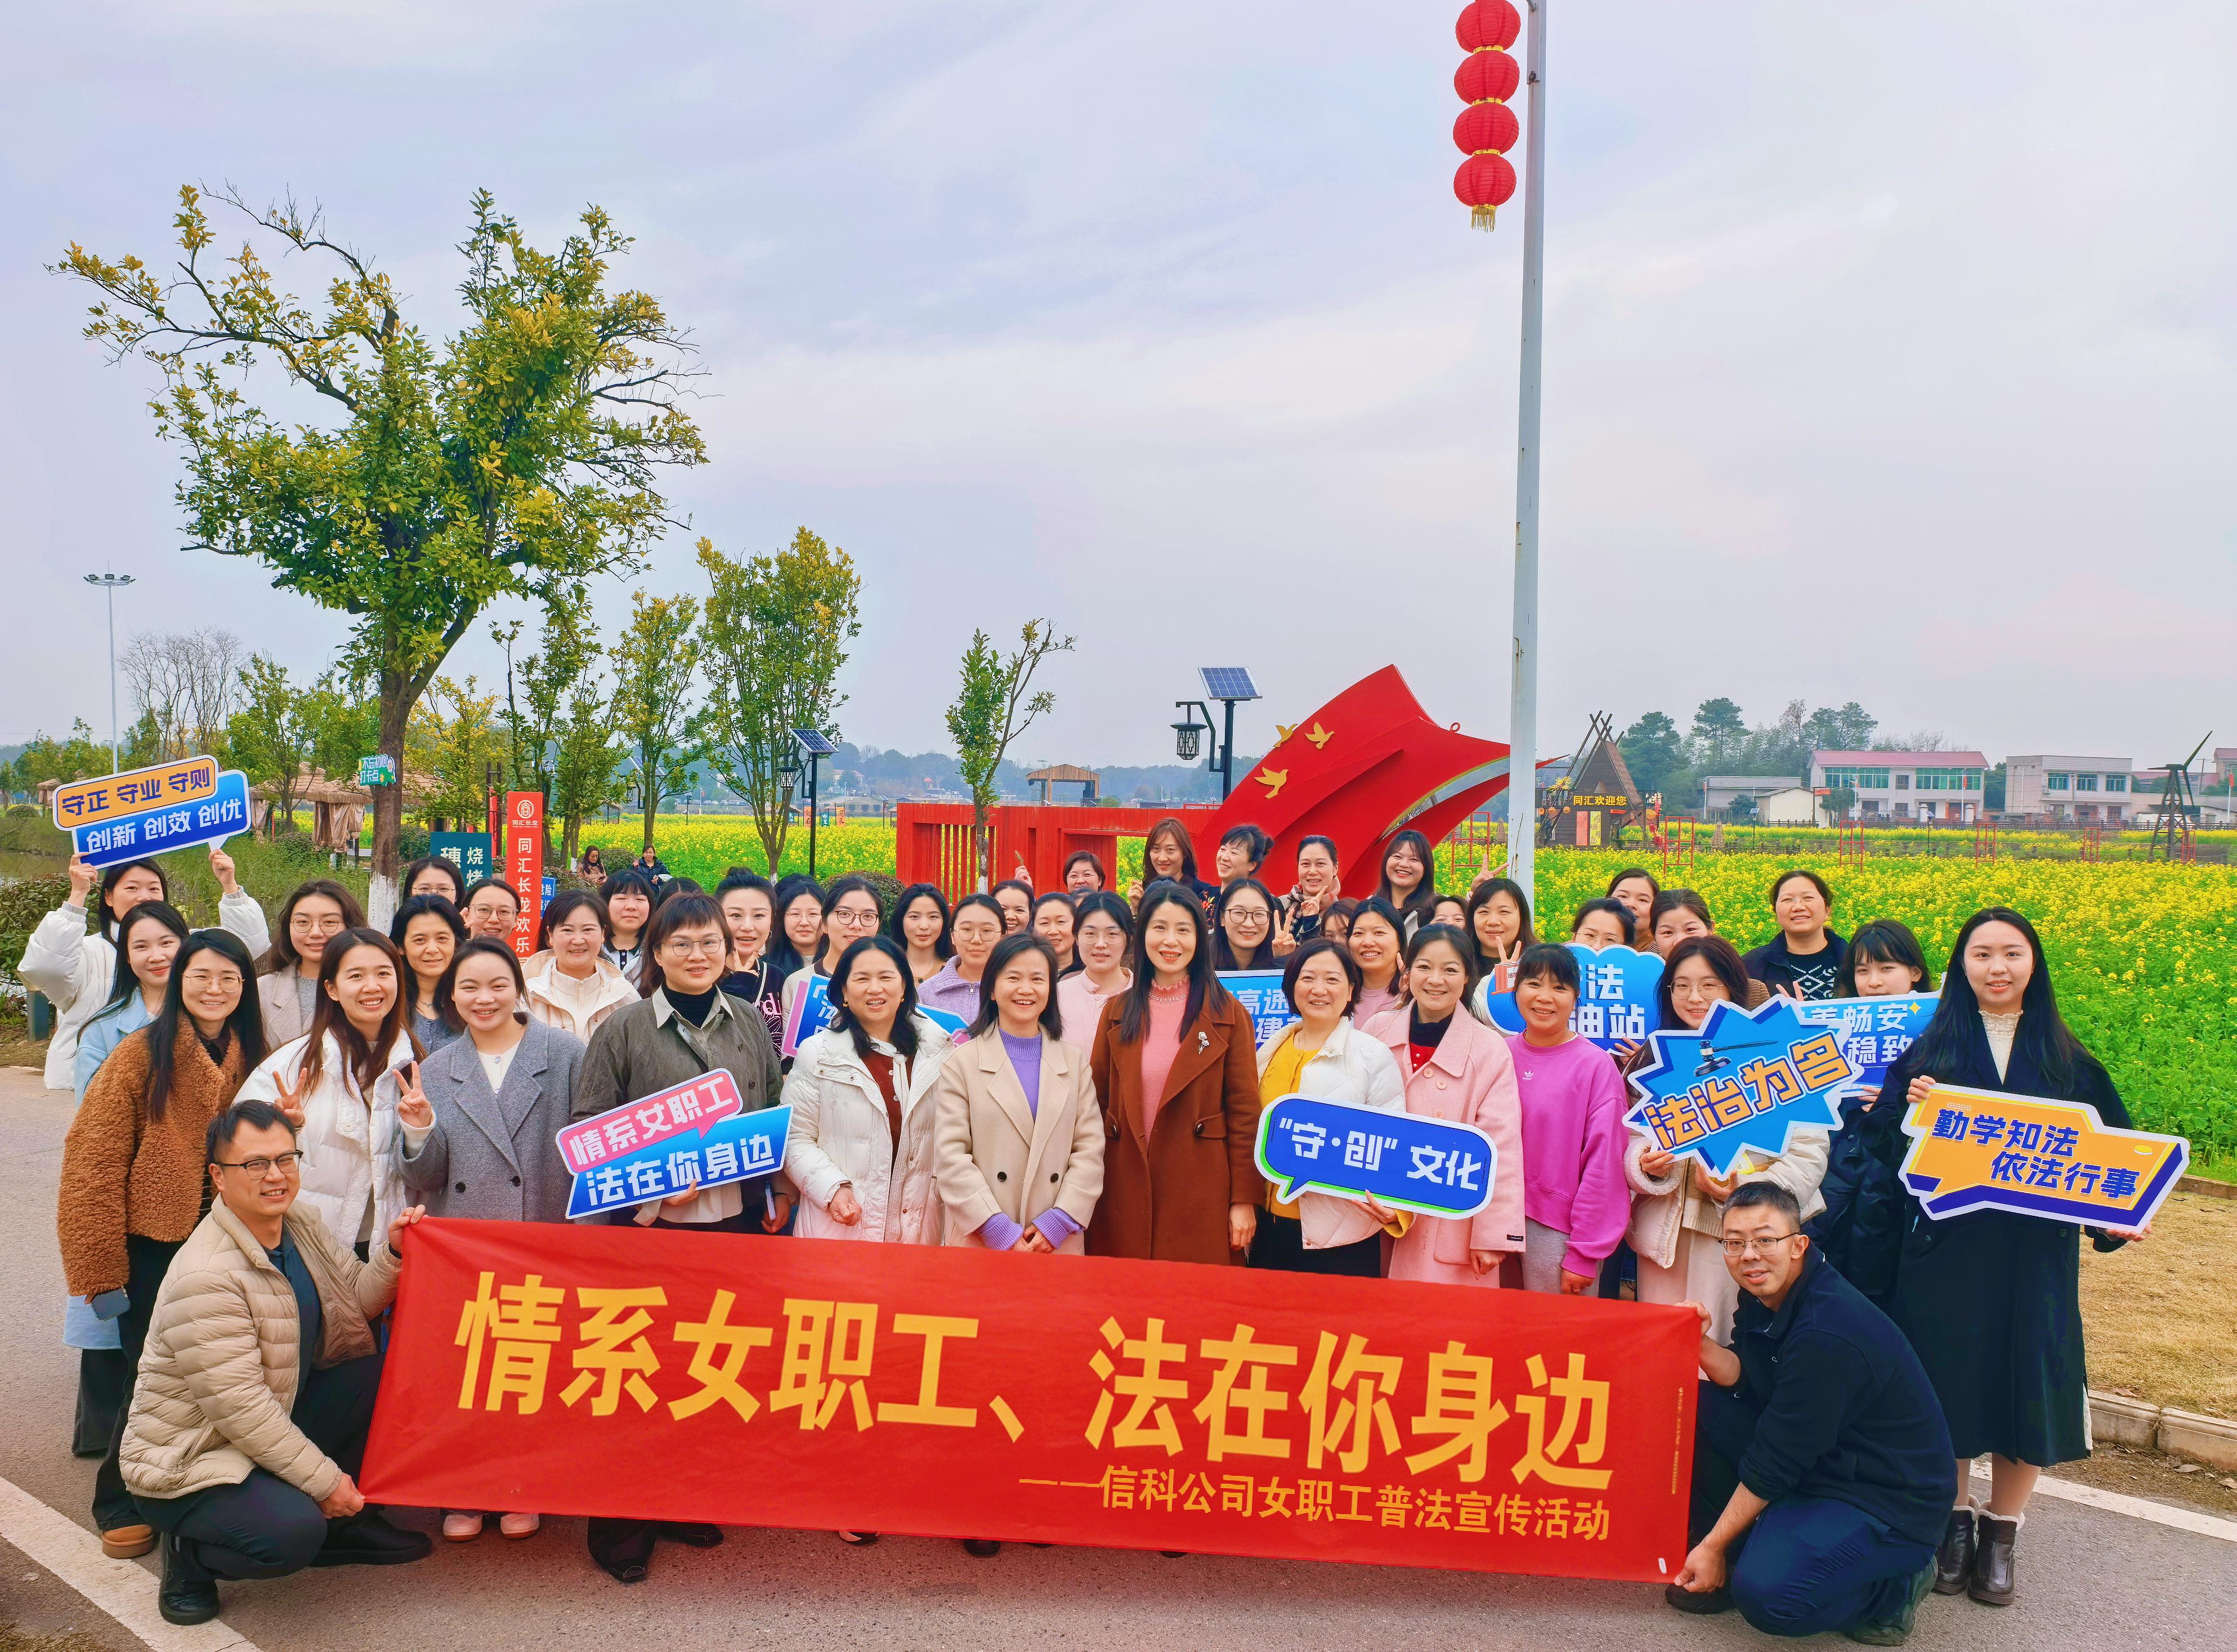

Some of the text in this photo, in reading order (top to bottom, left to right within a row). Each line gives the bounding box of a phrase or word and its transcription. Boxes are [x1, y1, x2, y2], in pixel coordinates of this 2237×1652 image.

[62, 767, 211, 816] 守正 守业 守则
[1573, 795, 1627, 806] 同汇欢迎您
[86, 798, 242, 852] 创新 创效 创优
[1644, 1032, 1852, 1150] 法治为名
[569, 1076, 733, 1166] 情系女职工
[1931, 1108, 2079, 1158] 勤学知法
[586, 1134, 775, 1206] 法在你身边
[1407, 1145, 1482, 1191] 文化
[1990, 1150, 2141, 1199] 依法行事
